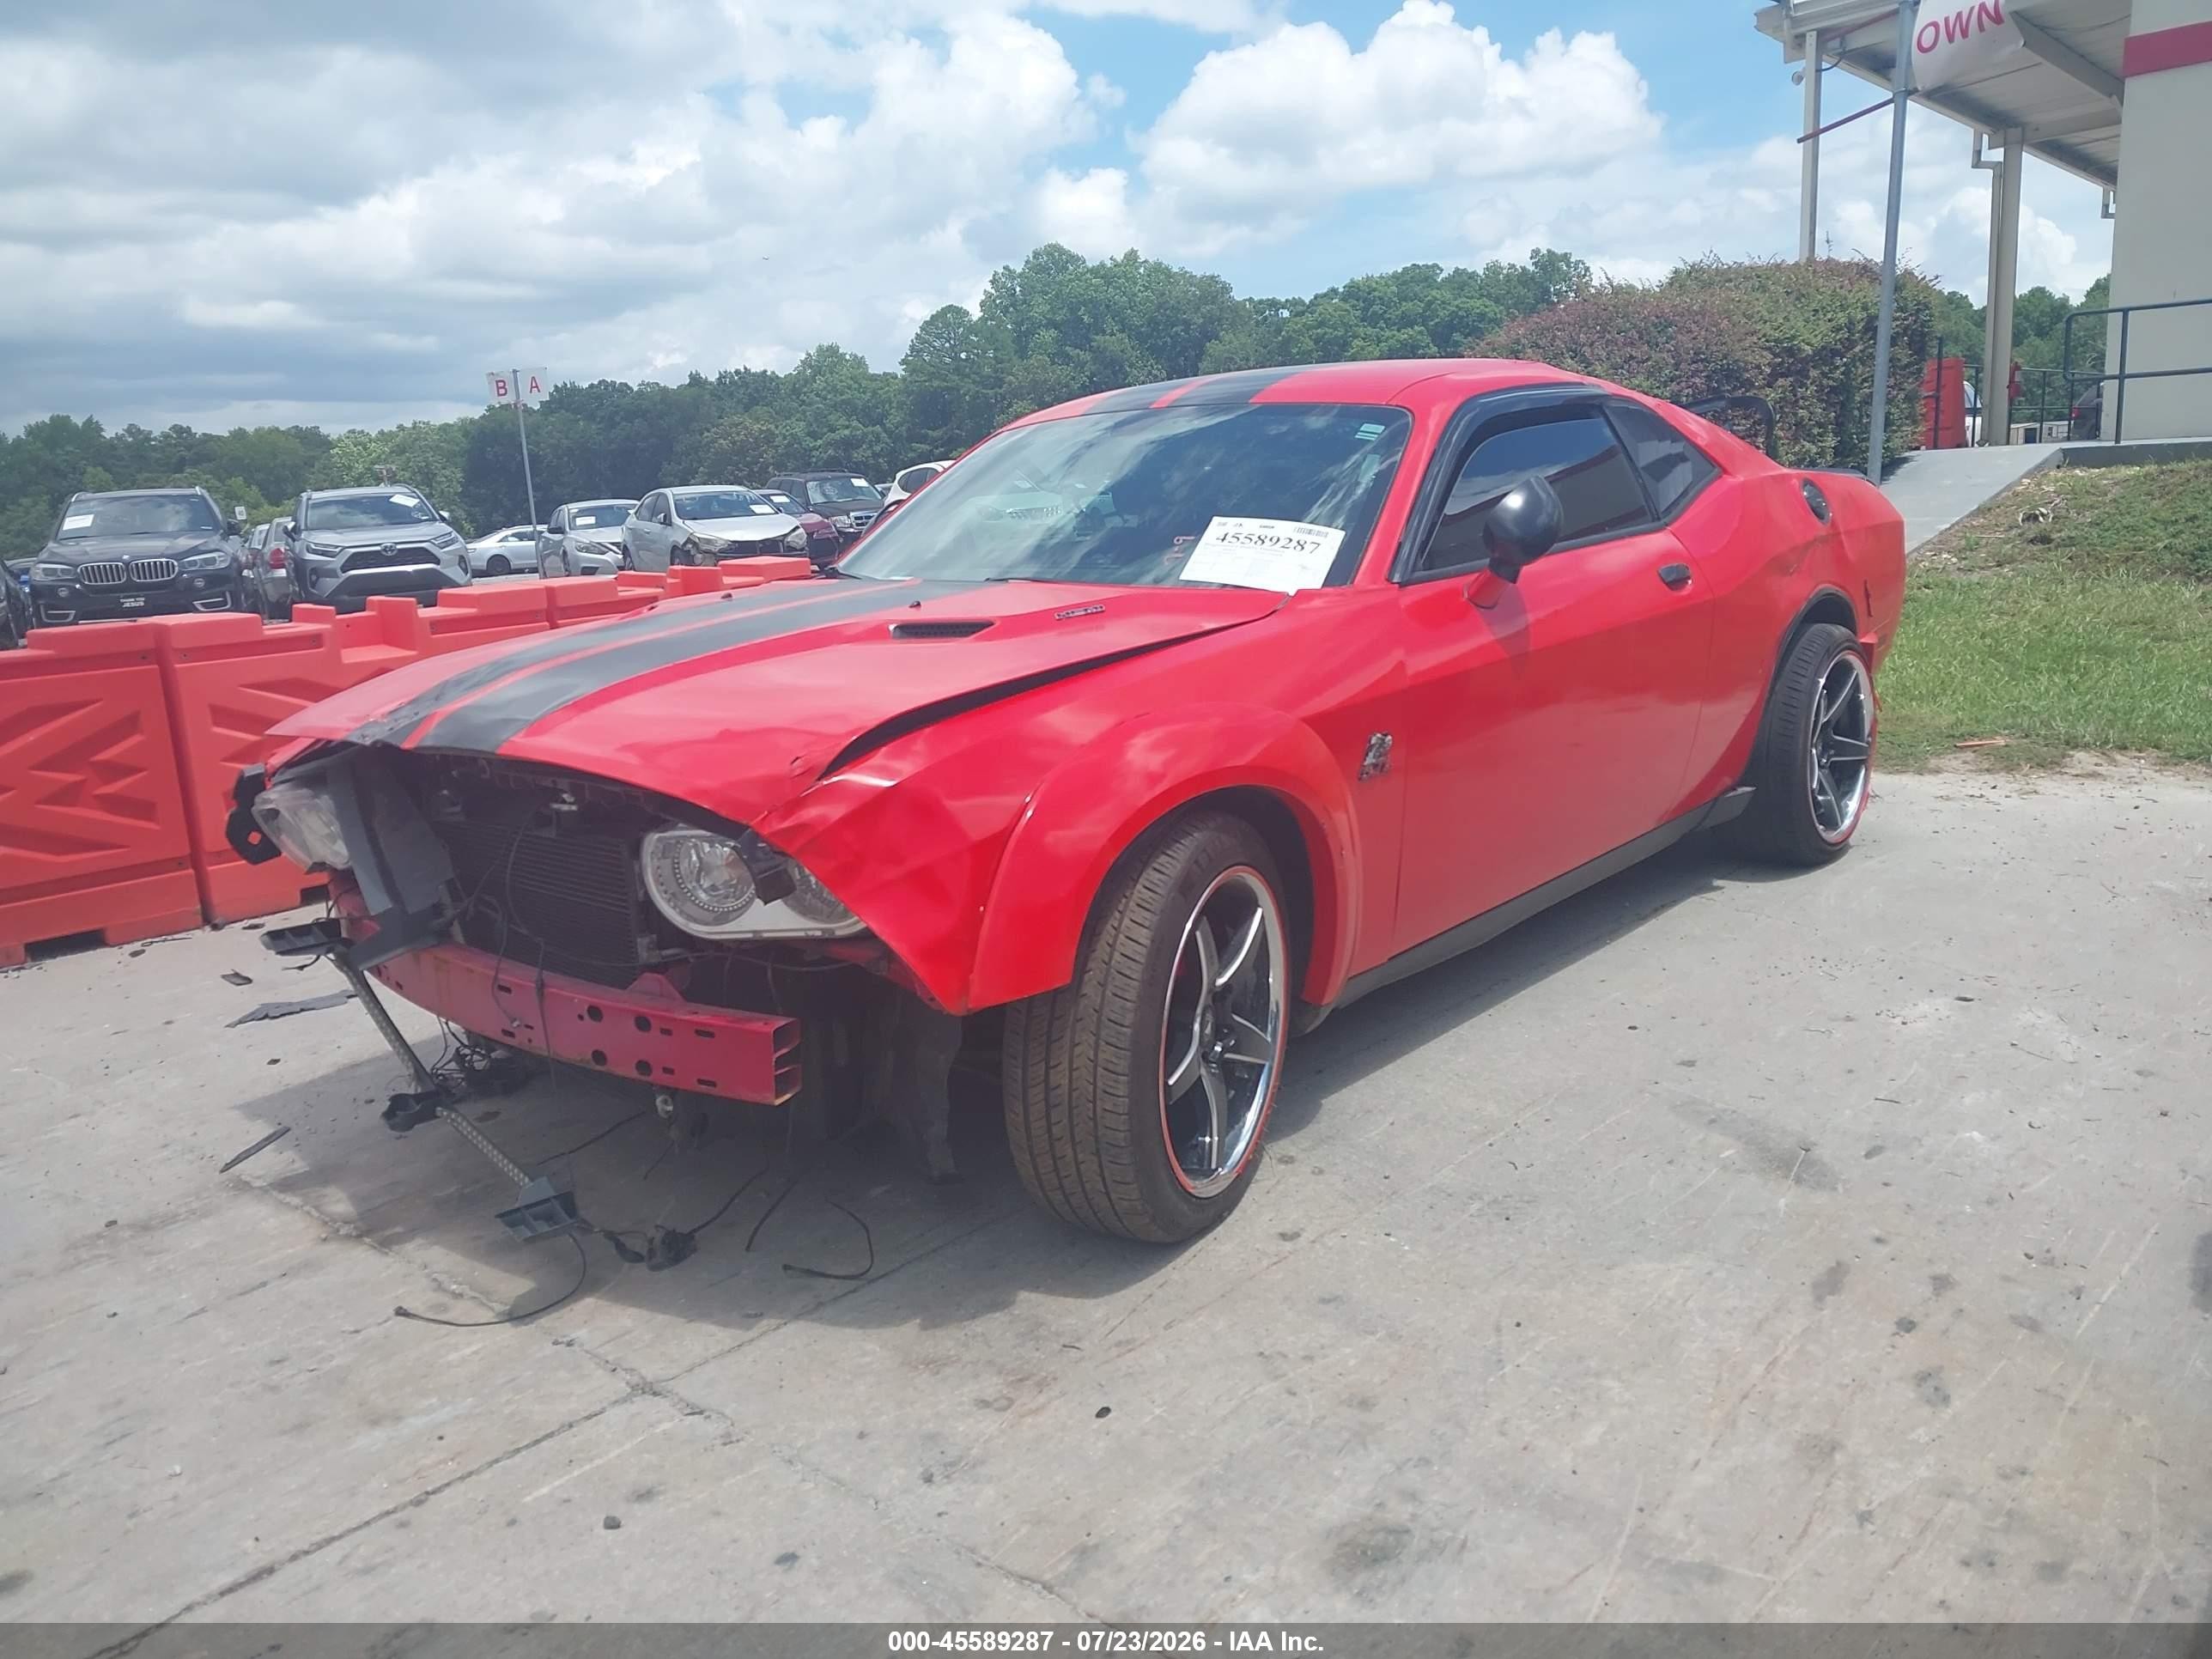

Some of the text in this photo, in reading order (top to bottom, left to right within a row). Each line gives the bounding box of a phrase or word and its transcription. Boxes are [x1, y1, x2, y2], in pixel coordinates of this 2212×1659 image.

[1917, 0, 2005, 53] OWN
[495, 380, 508, 397] B
[529, 376, 541, 393] A
[1215, 532, 1321, 555] 45589287
